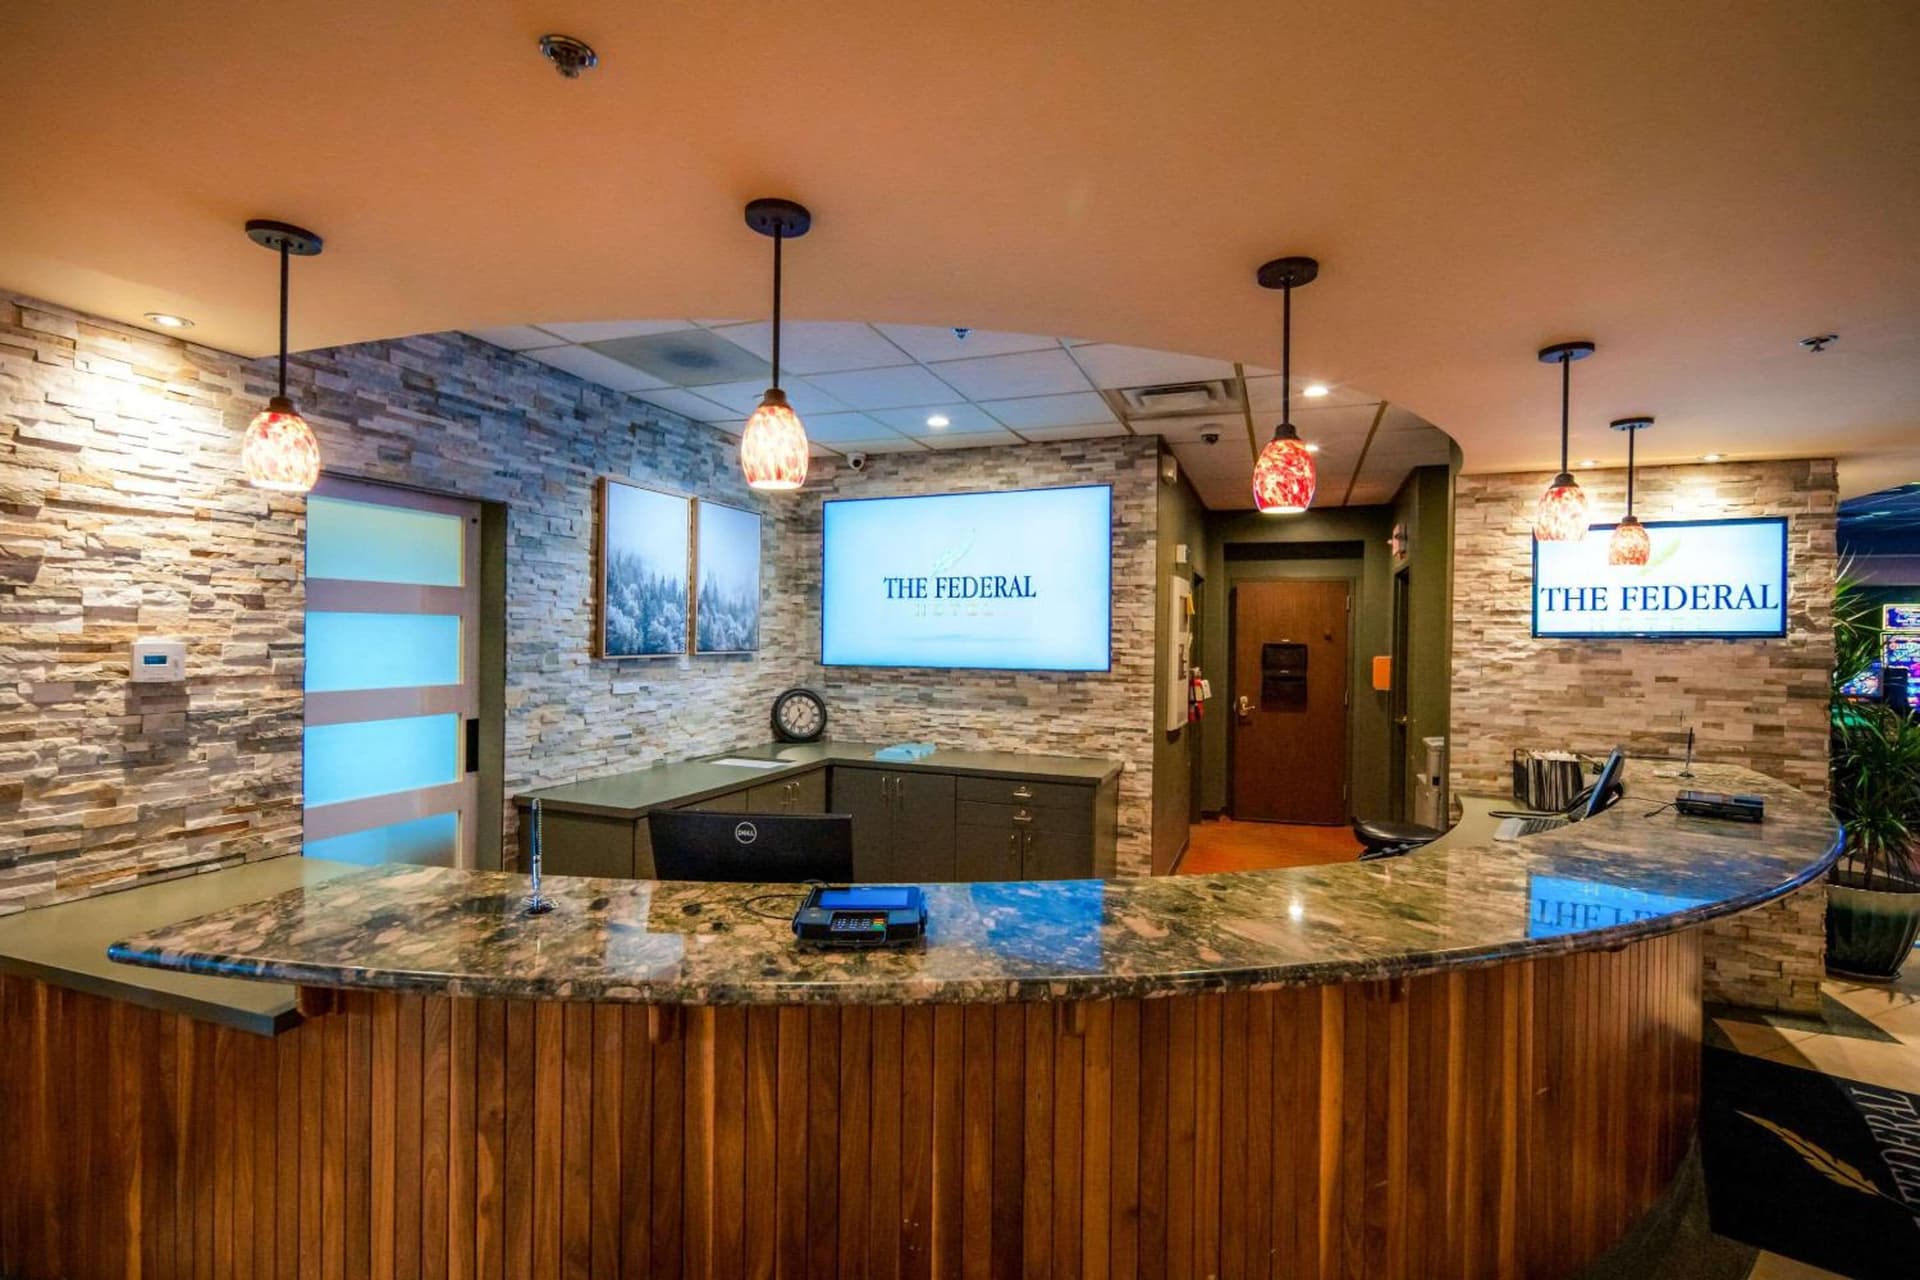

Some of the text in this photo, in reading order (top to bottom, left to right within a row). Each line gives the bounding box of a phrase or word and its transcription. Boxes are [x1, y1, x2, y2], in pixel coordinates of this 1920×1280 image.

[883, 575, 1037, 598] THE FEDERAL
[1541, 584, 1779, 611] THE FEDERAL
